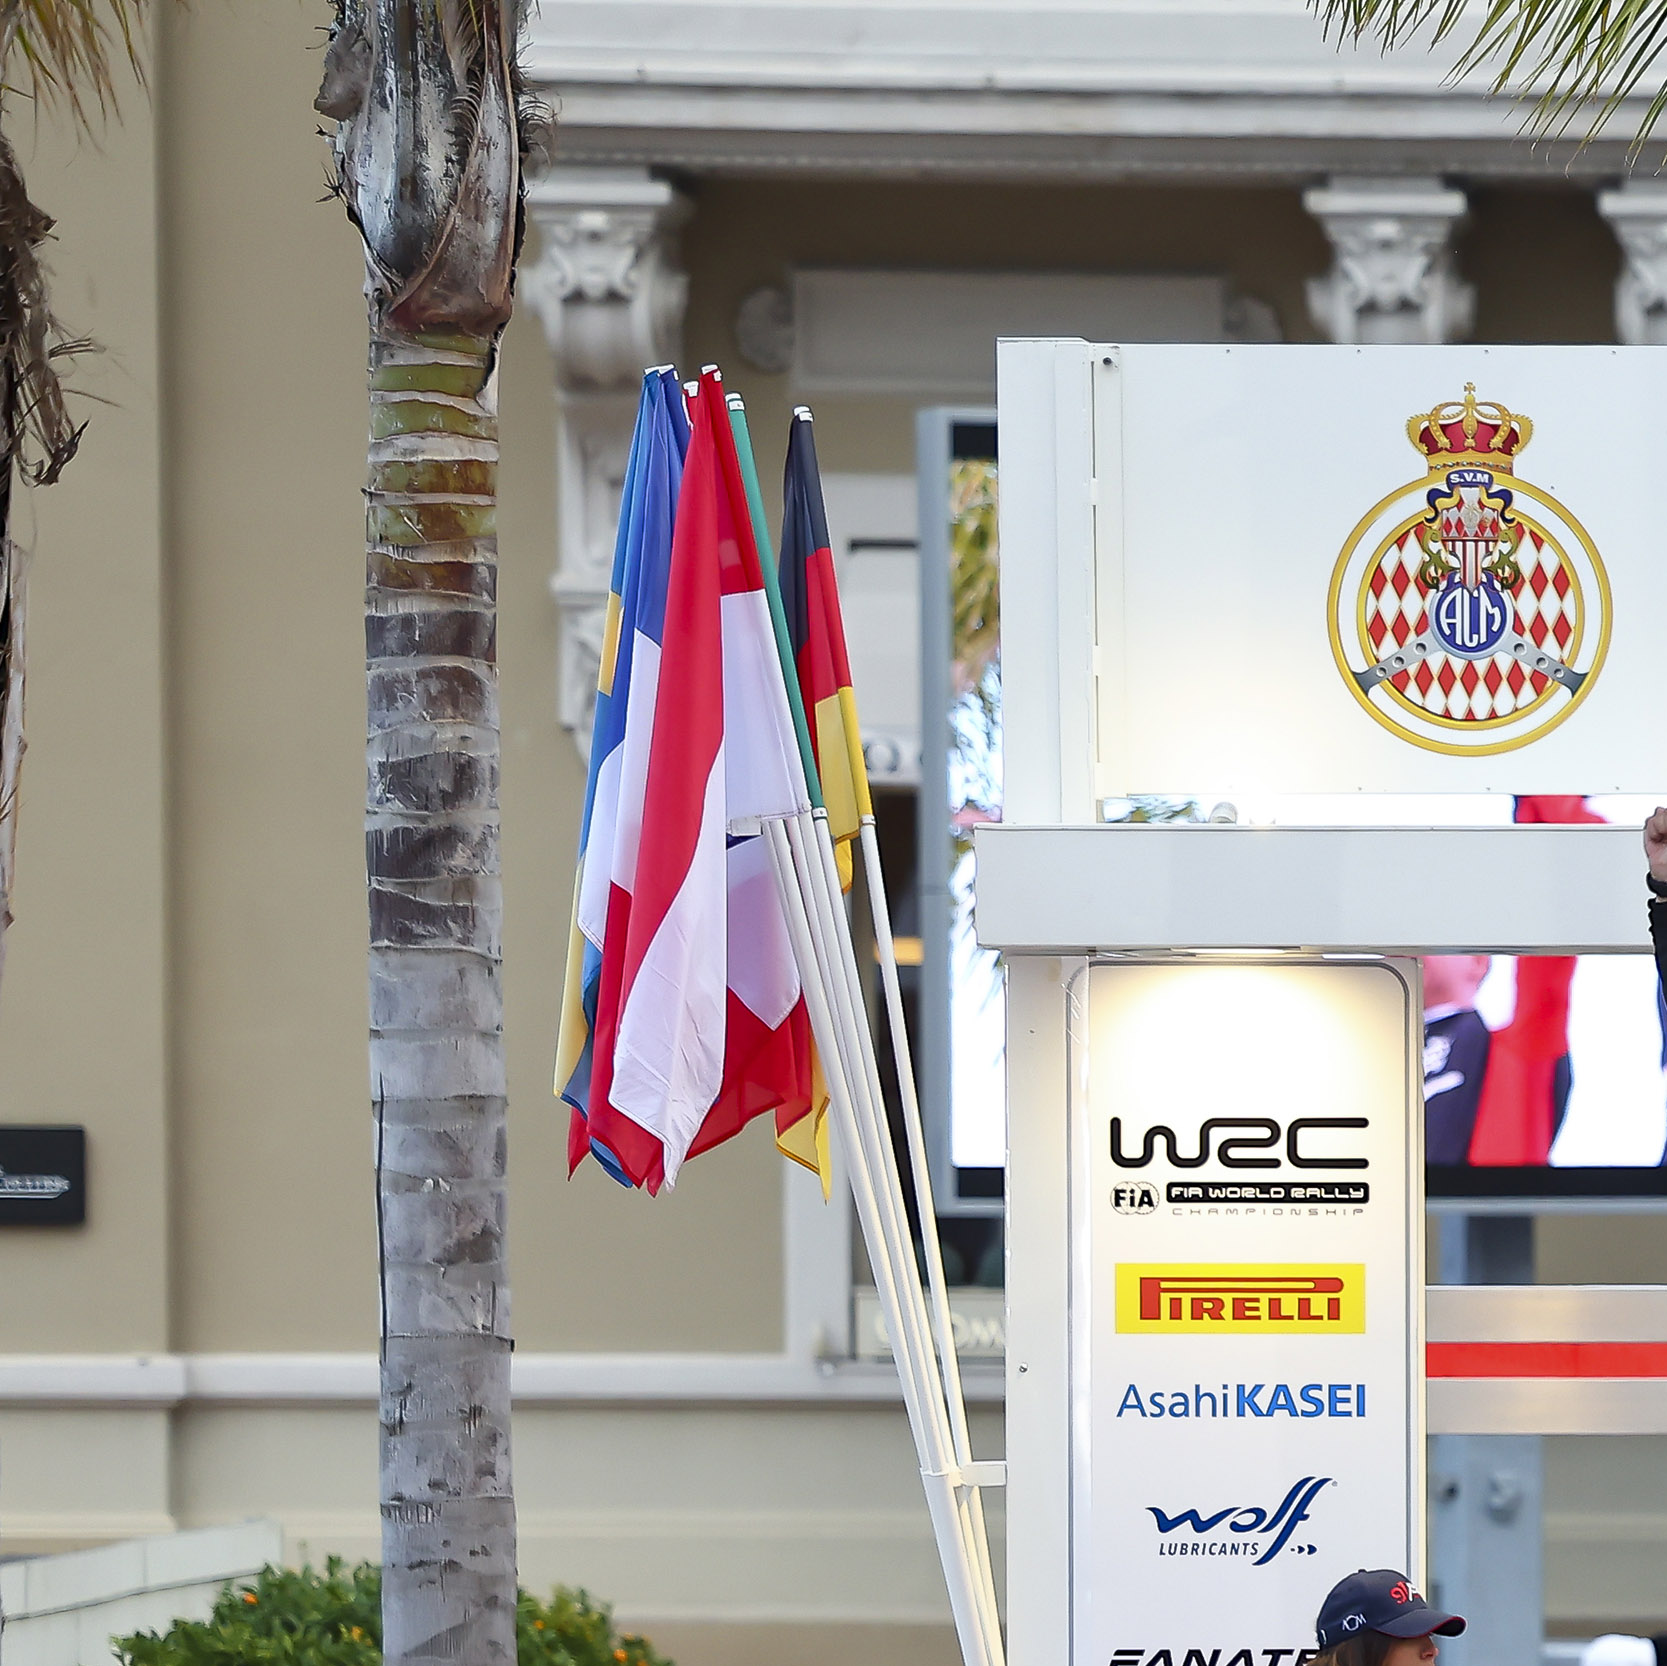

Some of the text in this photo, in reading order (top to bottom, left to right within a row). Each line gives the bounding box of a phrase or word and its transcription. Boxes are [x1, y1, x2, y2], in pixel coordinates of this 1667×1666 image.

[1110, 1117, 1369, 1168] WRC
[1171, 1187, 1364, 1199] FIA WORLD RALLY
[1172, 1208, 1363, 1216] CHAMPIONSHIP
[1139, 1277, 1344, 1320] PIRELLI
[1159, 1543, 1259, 1556] LUBRICANTS
